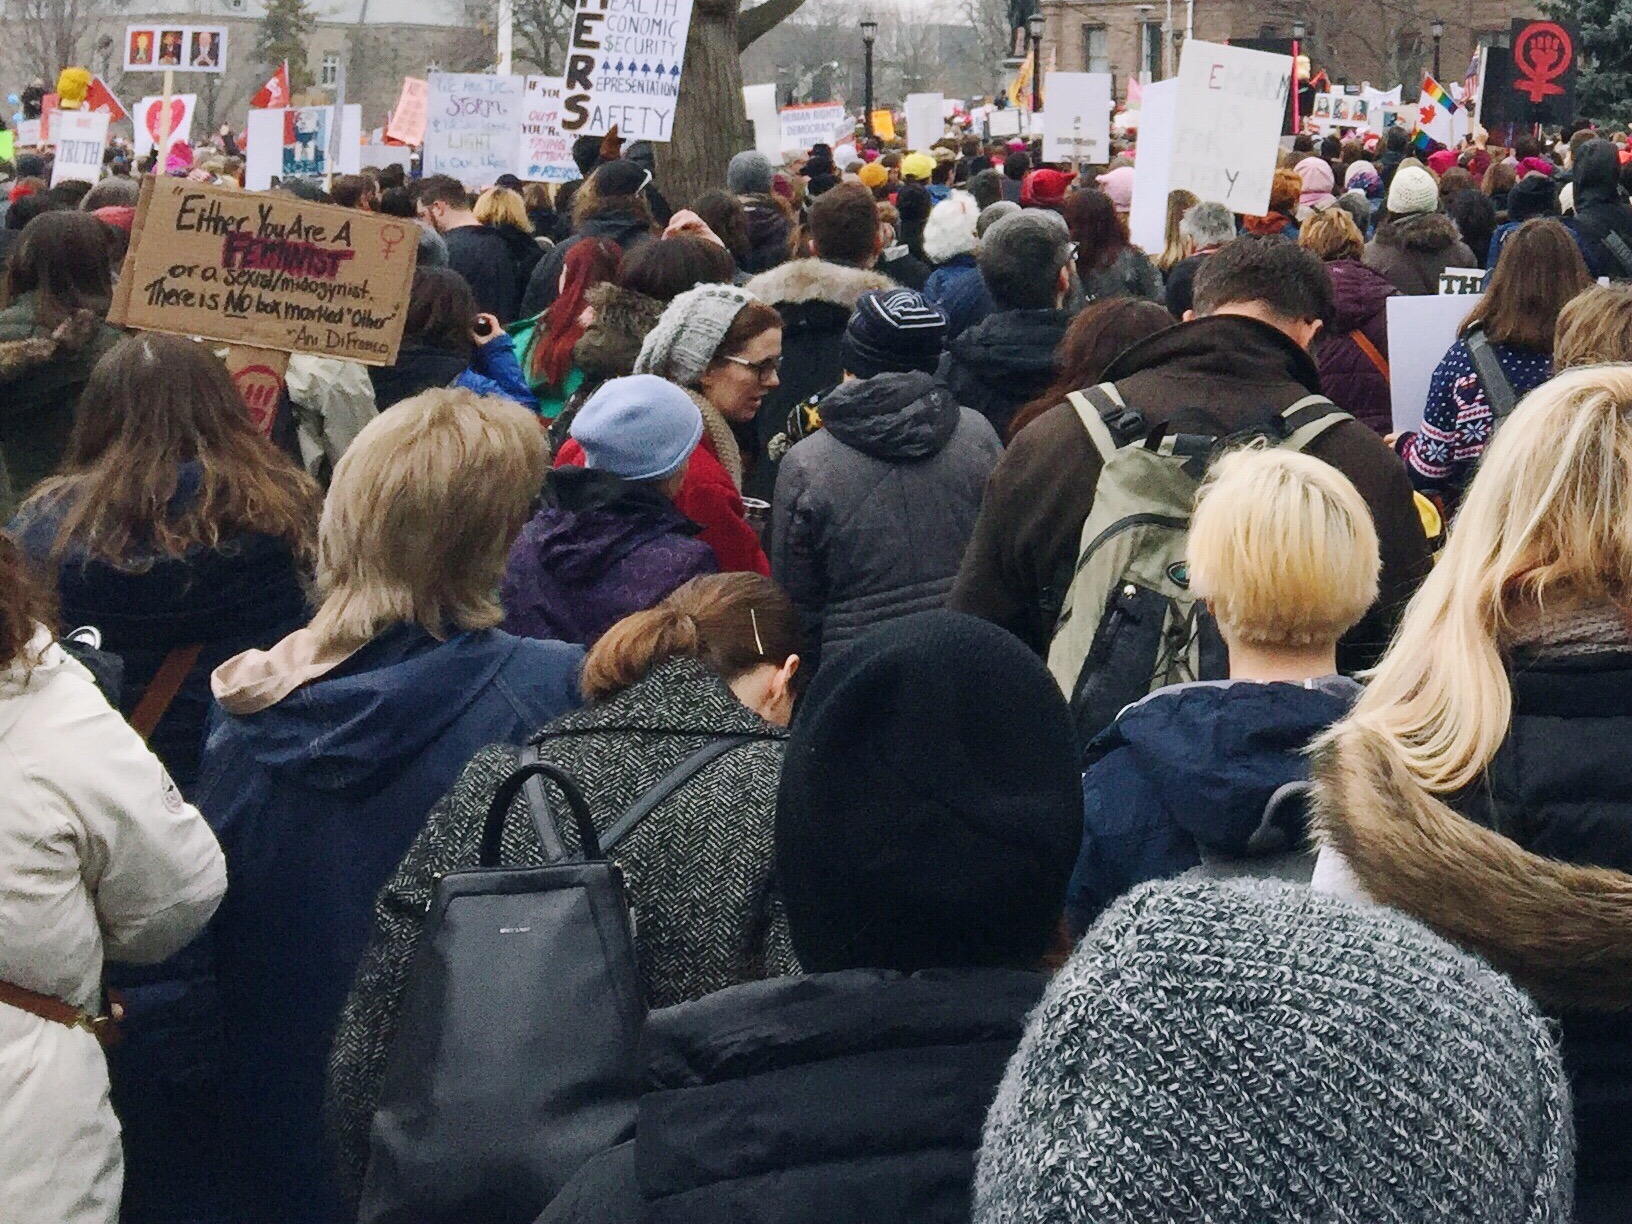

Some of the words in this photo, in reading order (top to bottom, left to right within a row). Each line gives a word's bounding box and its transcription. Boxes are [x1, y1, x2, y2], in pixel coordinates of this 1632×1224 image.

[787, 122, 835, 135] DEMOCRACY
[59, 139, 101, 165] TRUTH
[332, 221, 352, 247] A
[168, 264, 200, 278] or
[144, 276, 196, 308] There
[199, 291, 220, 311] is
[222, 288, 252, 314] NO
[256, 293, 281, 319] box
[284, 301, 344, 326] marked
